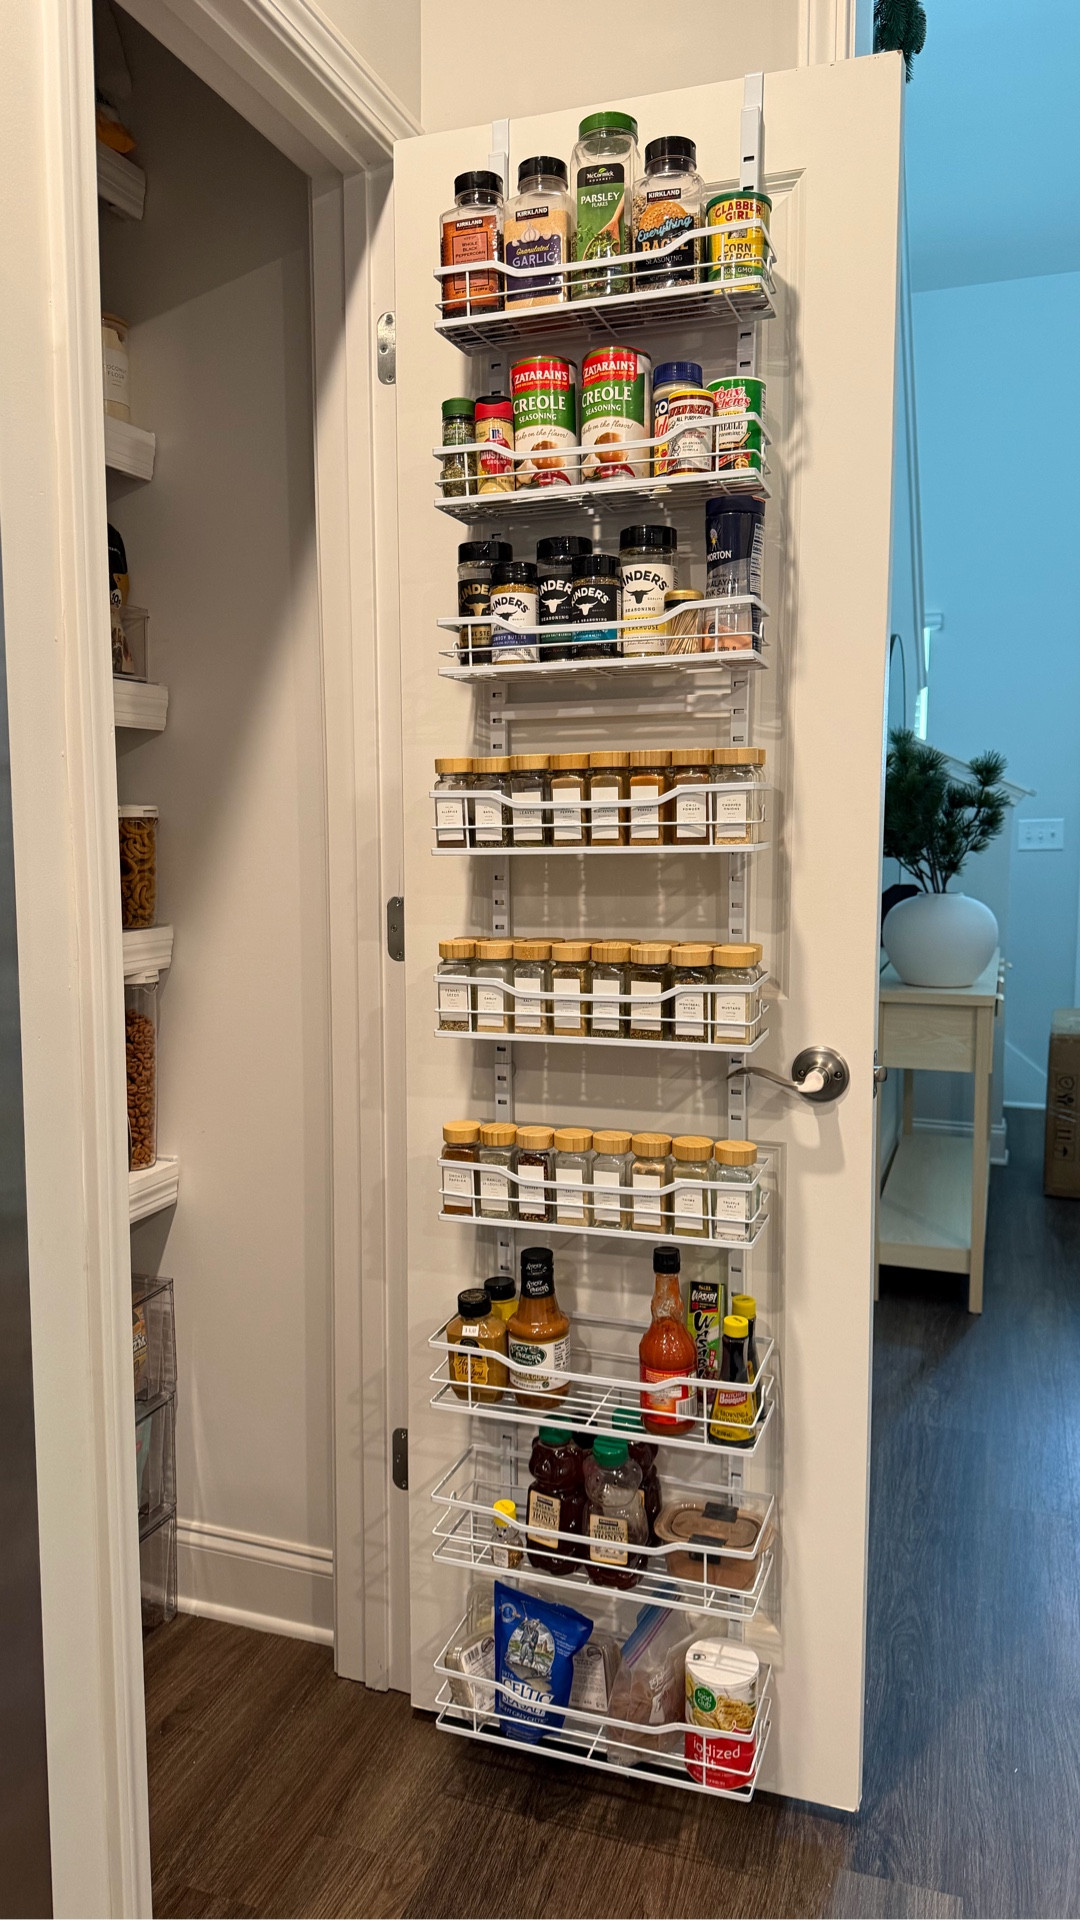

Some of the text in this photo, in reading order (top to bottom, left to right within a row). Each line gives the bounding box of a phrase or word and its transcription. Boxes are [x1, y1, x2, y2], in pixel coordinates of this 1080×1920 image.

[587, 171, 614, 183] McCormick
[581, 192, 620, 205] PARSLEY
[648, 190, 680, 199] KIRKLAND
[517, 207, 548, 218] KIRKLAND
[714, 200, 763, 219] CLABBER
[725, 210, 751, 222] GIRL
[456, 219, 483, 229] KIRKLAND
[637, 216, 693, 243] Everything
[455, 250, 486, 259] PEPPERCORN
[516, 243, 550, 256] Granulated
[723, 243, 752, 255] CORN
[512, 251, 556, 267] GARLIC
[645, 255, 683, 266] SEASONING
[107, 371, 125, 379] FLOUR
[583, 361, 635, 379] ZATARAIN'S
[514, 370, 569, 386] ZATARAIN'S
[581, 386, 633, 408] CREOLE
[513, 395, 566, 416] CREOLE
[585, 403, 621, 417] SEASONING
[518, 412, 557, 424] SEASONING
[600, 420, 610, 430] the
[536, 428, 547, 437] the
[717, 587, 737, 597] SALT
[540, 615, 570, 623] SEASONING
[692, 1290, 718, 1303] WASABI
[534, 1503, 556, 1513] ORGANIC
[532, 1511, 557, 1526] HONEY
[596, 1525, 621, 1533] ORGANIC
[594, 1533, 625, 1543] HONEY
[502, 1677, 554, 1703] CELTIC
[503, 1693, 521, 1709] SEA
[697, 1691, 713, 1703] food
[697, 1698, 712, 1709] club
[693, 1736, 741, 1759] iodized
